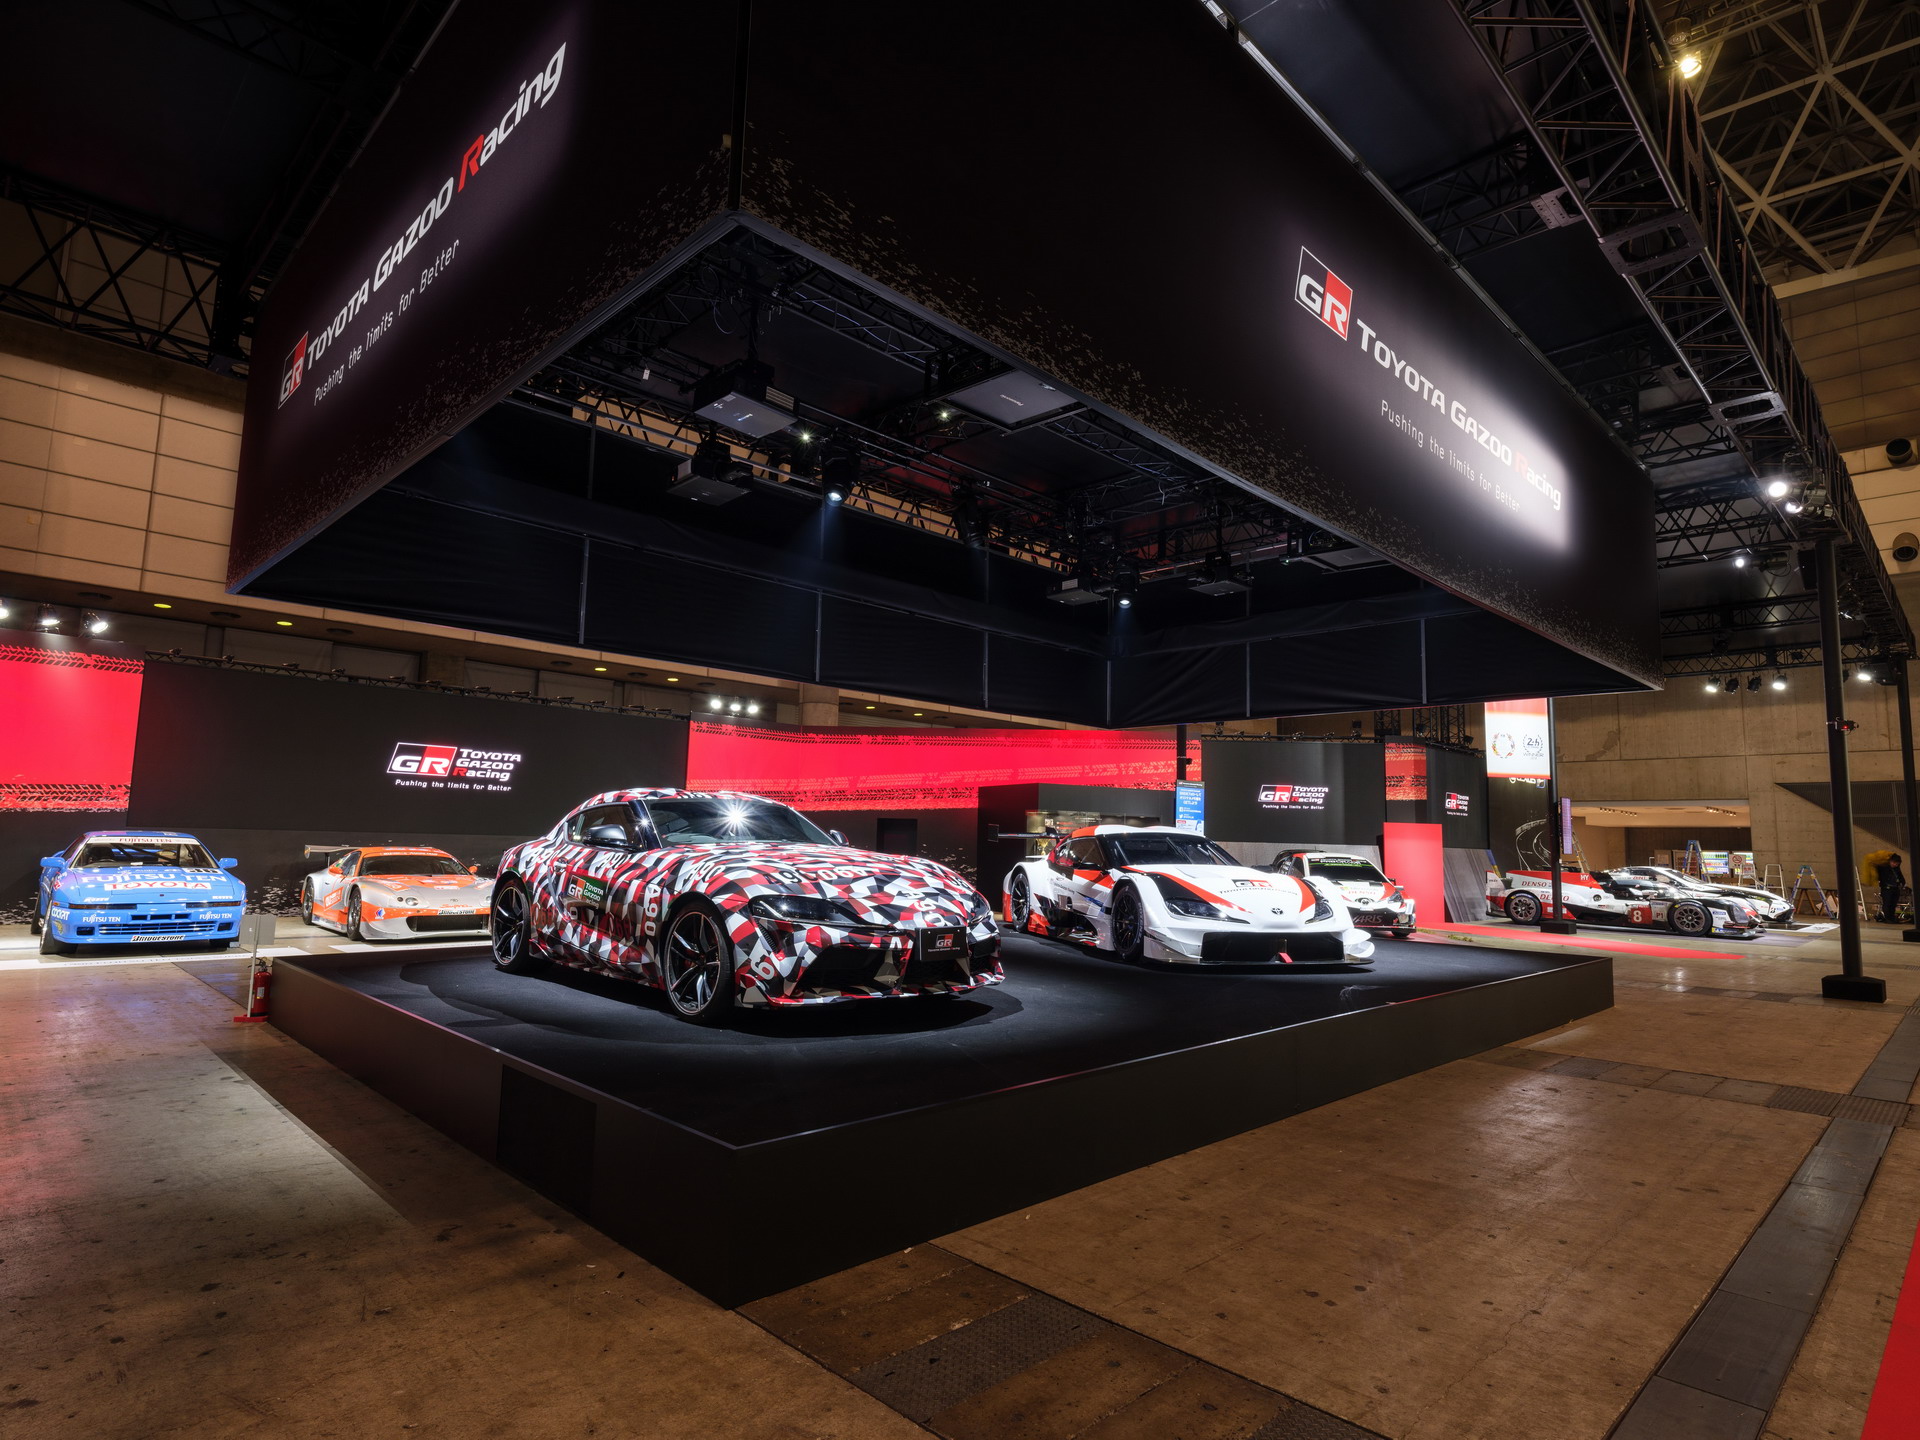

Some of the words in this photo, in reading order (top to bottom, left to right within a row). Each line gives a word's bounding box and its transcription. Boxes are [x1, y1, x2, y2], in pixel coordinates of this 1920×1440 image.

[308, 278, 369, 370] TOYOTA
[373, 177, 454, 292] GAZOO
[458, 41, 566, 193] Racing
[1299, 274, 1348, 335] GR
[314, 364, 344, 406] Pushing
[348, 343, 362, 369] the
[366, 311, 394, 351] limits
[399, 287, 415, 316] for
[420, 239, 459, 294] Better
[280, 357, 302, 402] GR
[1356, 318, 1446, 415] TOYOTA
[1451, 400, 1512, 467] GAZOO
[1515, 452, 1561, 511] Racing
[1381, 399, 1423, 447] Pushing
[1430, 435, 1445, 460] the
[1449, 450, 1475, 481] limits
[1479, 473, 1492, 493] for
[1495, 484, 1521, 513] Better
[460, 748, 521, 762] TOYOTA
[391, 755, 451, 774] GR
[456, 758, 514, 770] GAZOO
[452, 767, 511, 781] Racing
[395, 779, 427, 788] Pushing
[1260, 791, 1290, 801] GR
[1291, 796, 1323, 804] Racing
[1445, 798, 1457, 809] GR
[81, 872, 175, 883] FUJITSU
[181, 874, 227, 882] TEN
[684, 860, 726, 883] A90
[111, 881, 208, 890] TOYOTA
[568, 884, 582, 899] GR
[585, 882, 604, 895] TOYOTA
[583, 890, 600, 901] GAZOO
[199, 912, 220, 920] FUJITSU
[643, 882, 661, 937] A90
[82, 915, 107, 923] FUJITSU
[1633, 910, 1642, 923] 8
[936, 939, 953, 947] GR
